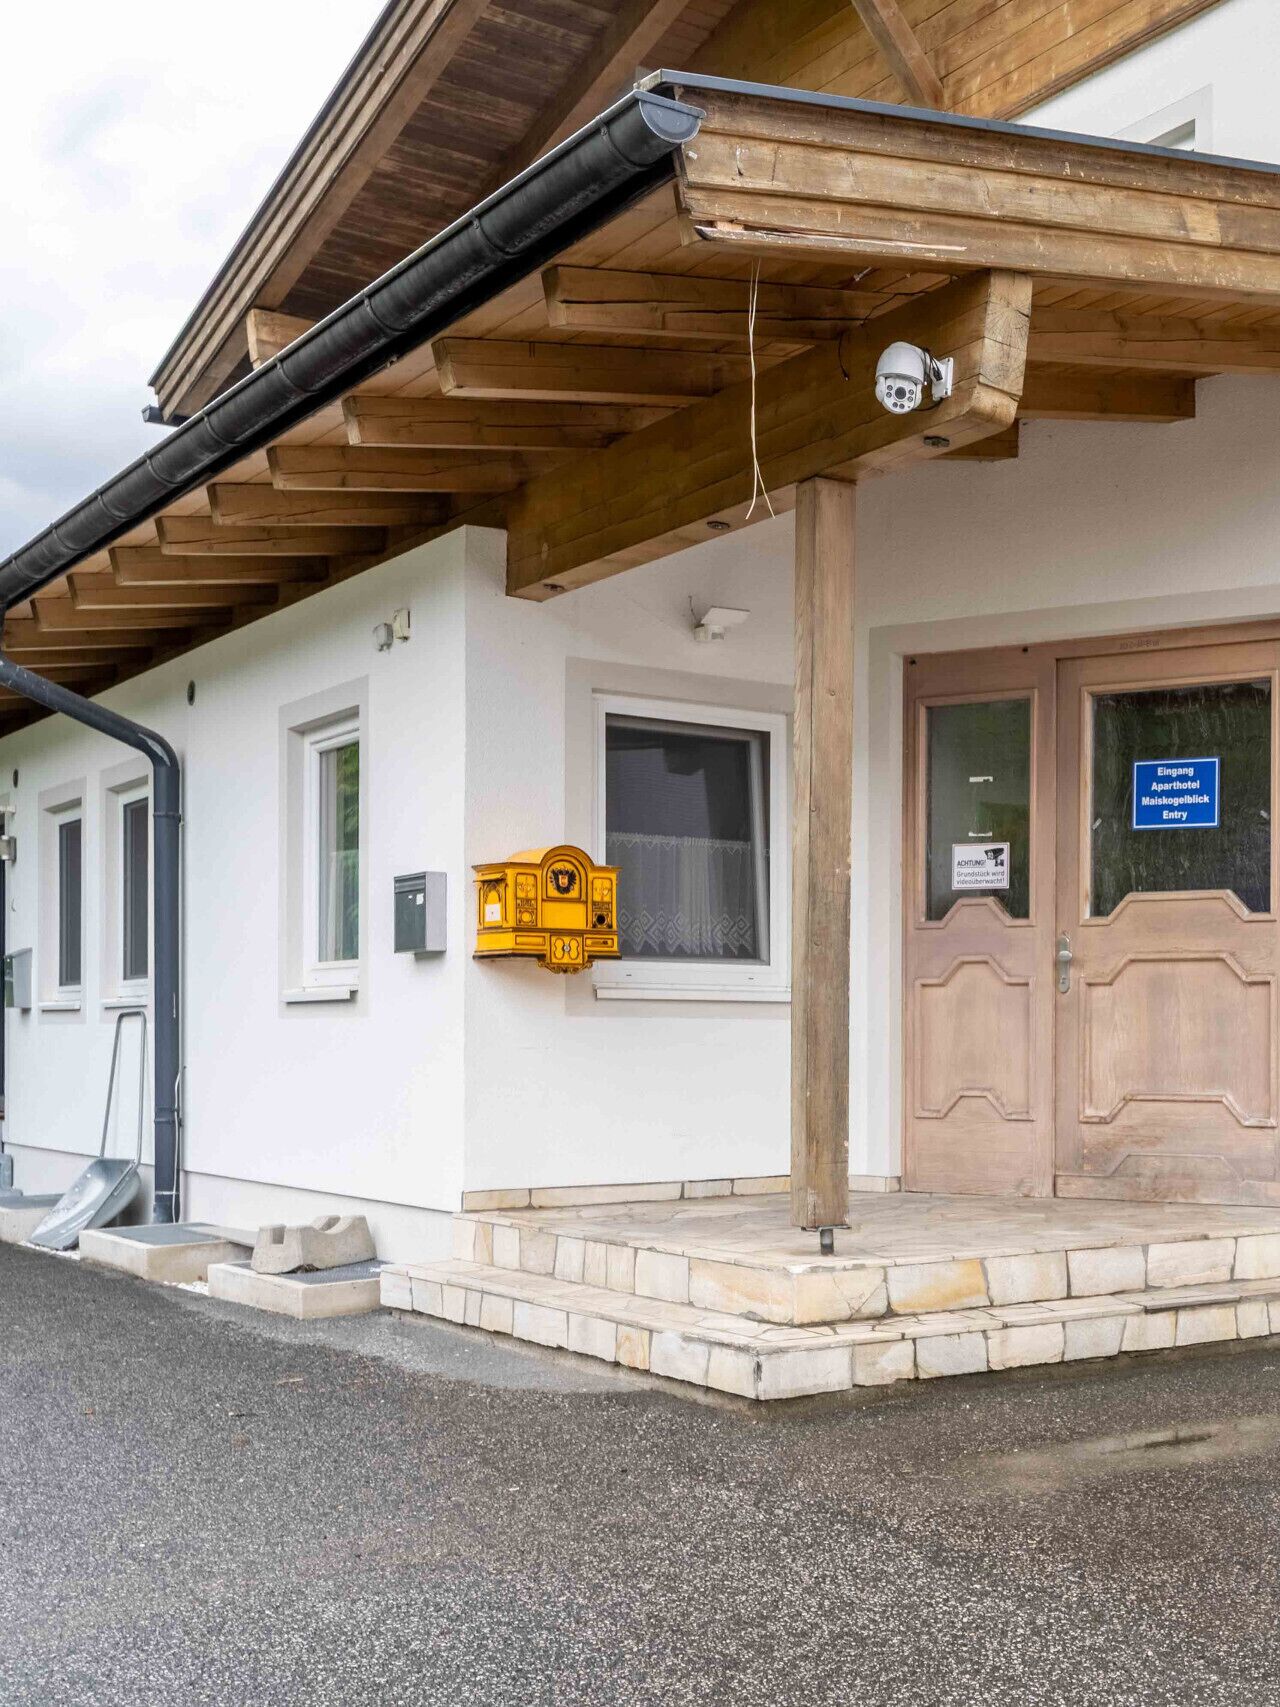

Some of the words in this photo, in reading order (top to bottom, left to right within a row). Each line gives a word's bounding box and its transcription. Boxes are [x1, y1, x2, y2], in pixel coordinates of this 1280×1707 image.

[1157, 767, 1194, 777] Eingang
[1151, 780, 1200, 792] Aparthotel
[1141, 795, 1210, 806] Maiskogelblick
[1162, 810, 1187, 821] Entry
[957, 859, 986, 867] ACHTUNG!
[956, 870, 990, 878] Grundstück
